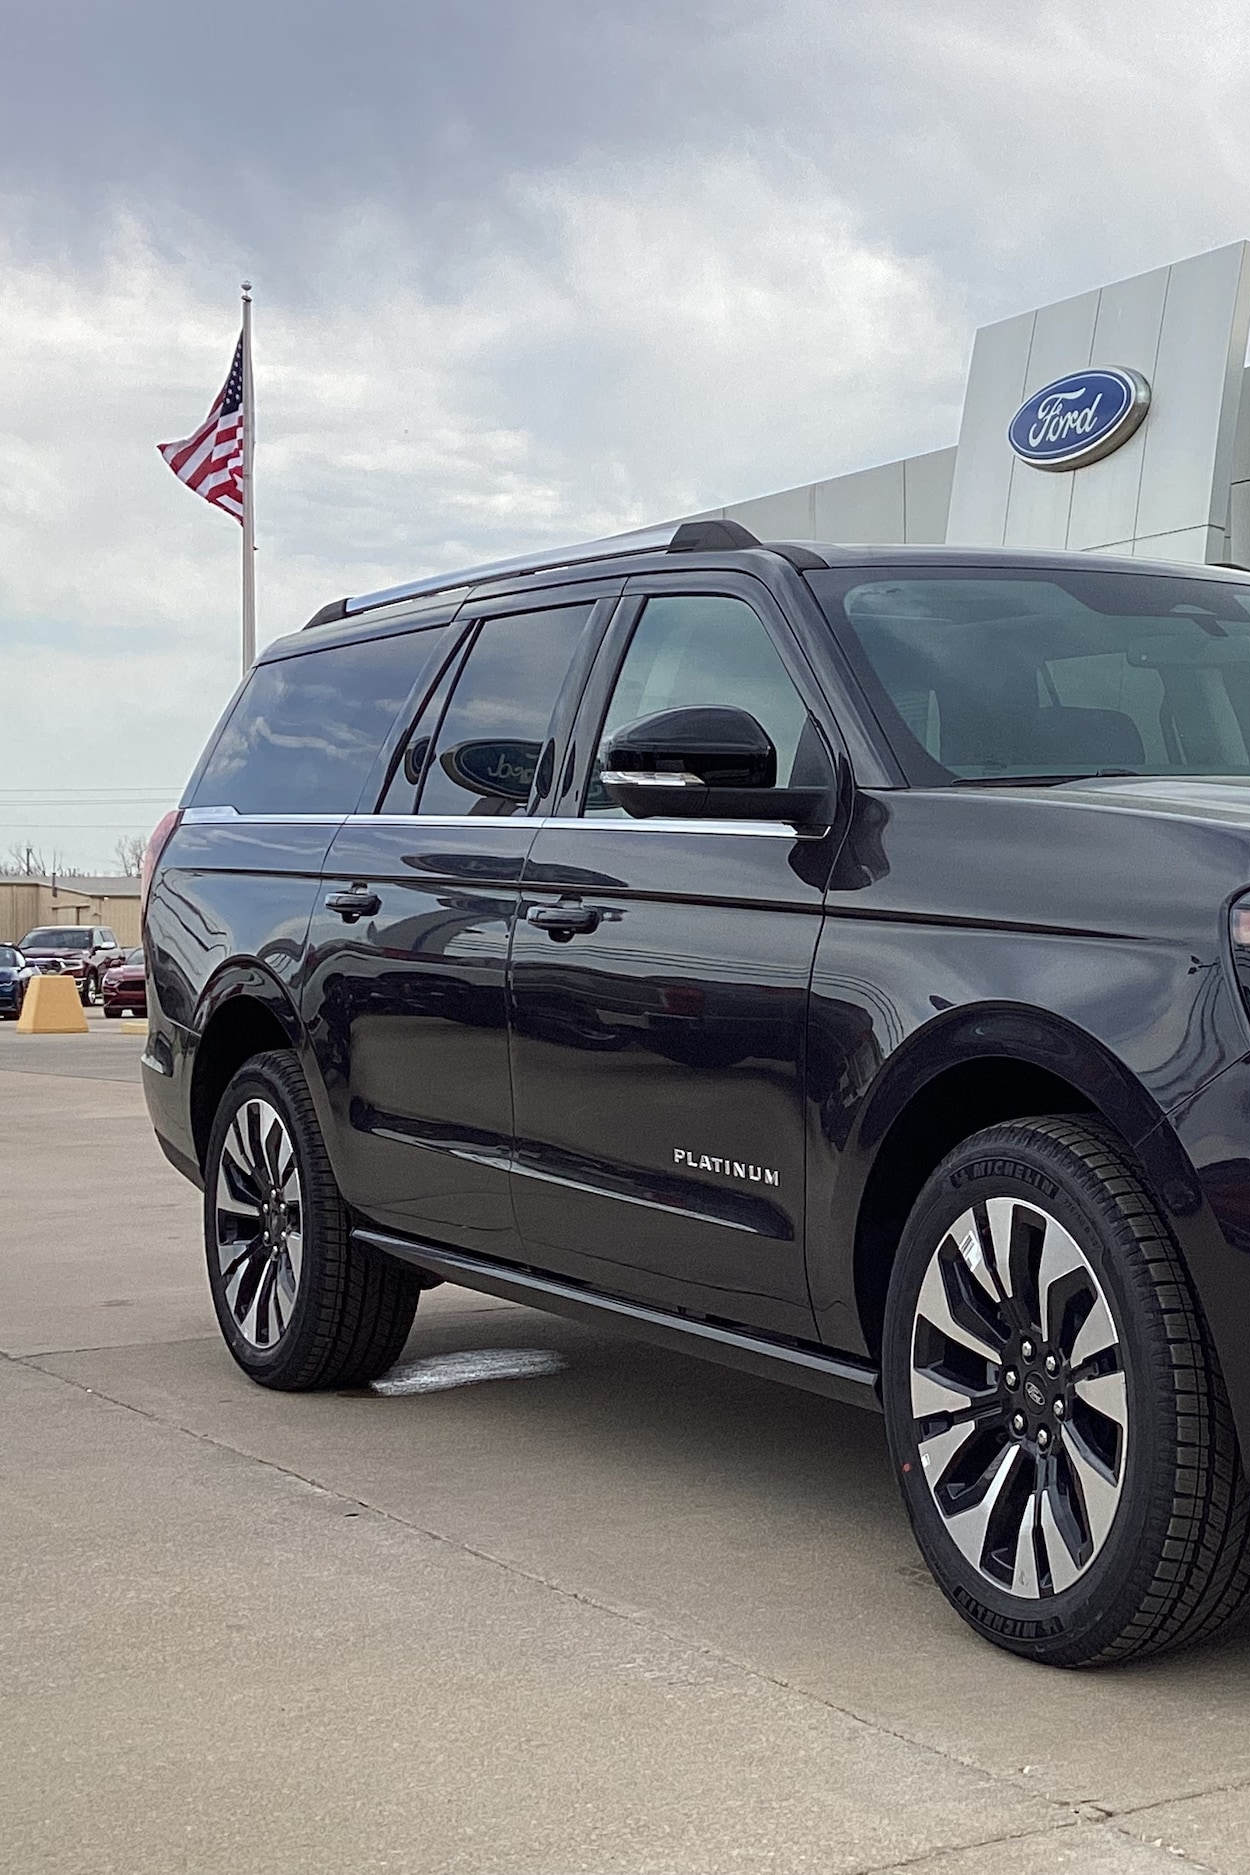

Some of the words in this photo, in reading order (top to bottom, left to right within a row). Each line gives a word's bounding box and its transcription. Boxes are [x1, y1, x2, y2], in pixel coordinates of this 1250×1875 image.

[1029, 387, 1103, 448] Ford
[673, 1147, 779, 1187] PLATINUM
[973, 1160, 1055, 1198] MICHELIN
[957, 1590, 1037, 1638] MICHELIN
